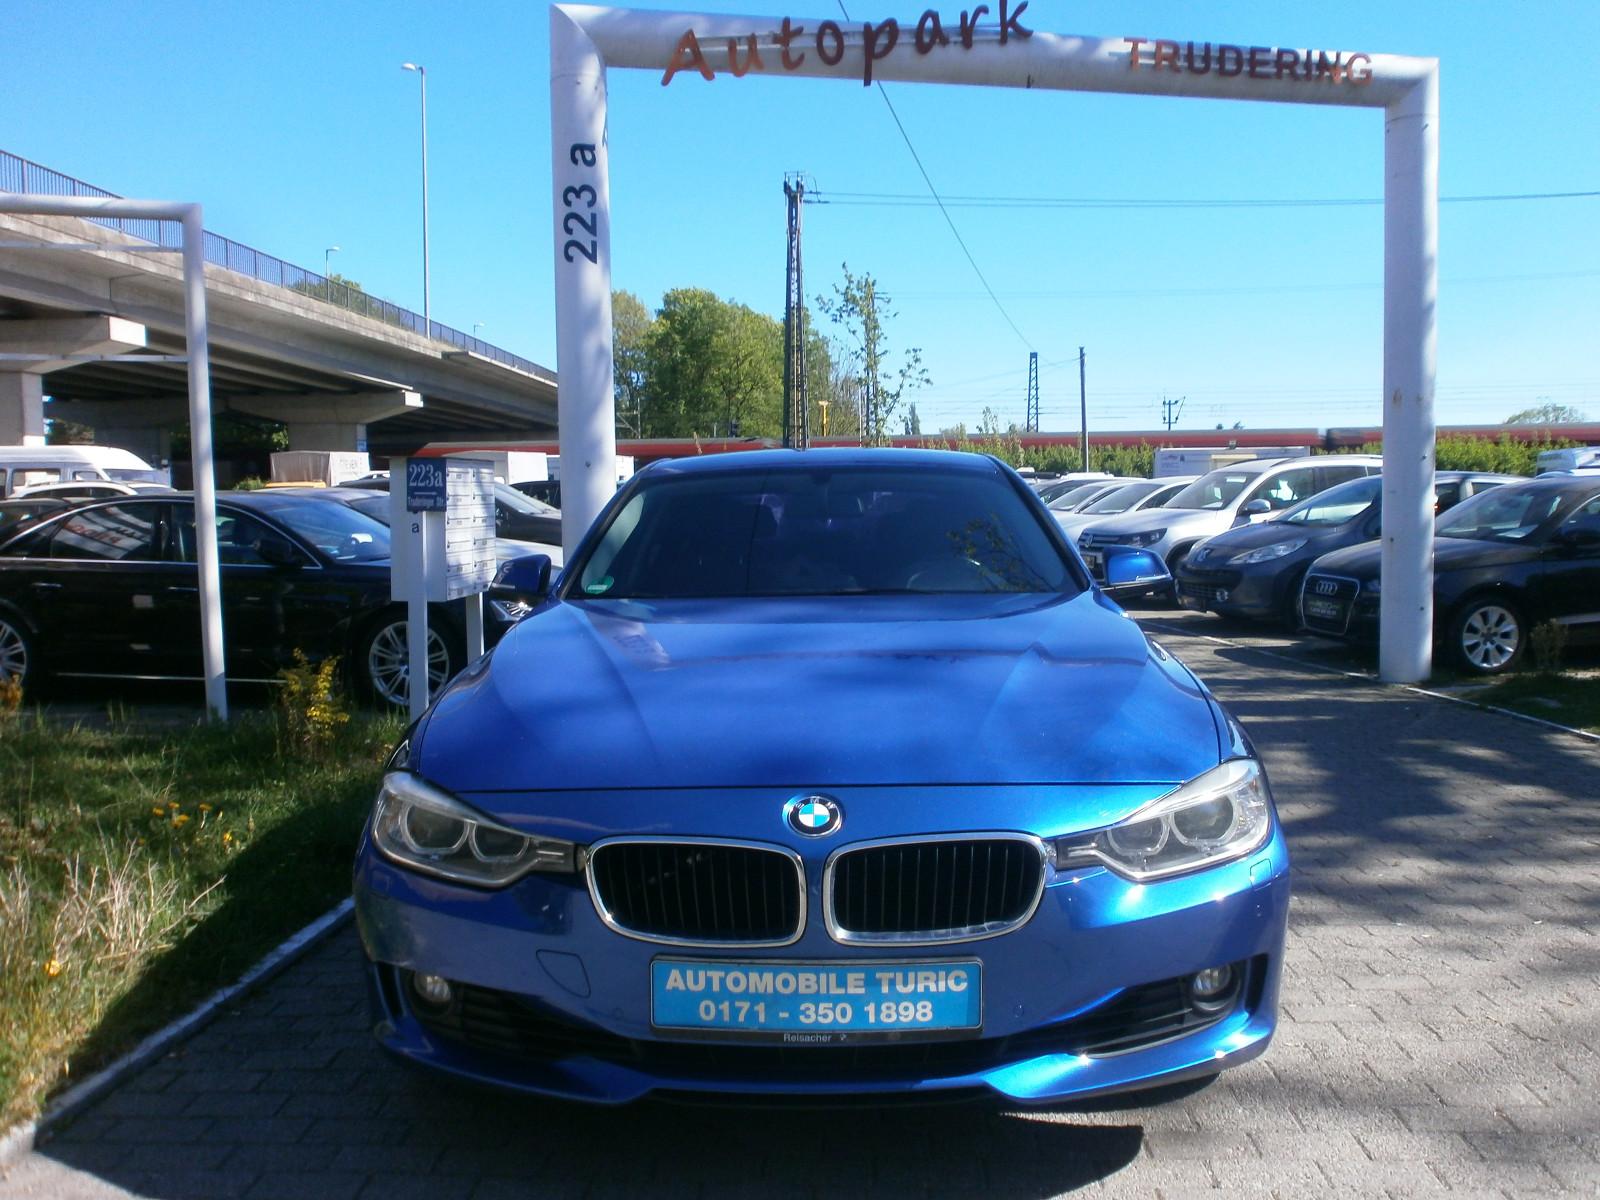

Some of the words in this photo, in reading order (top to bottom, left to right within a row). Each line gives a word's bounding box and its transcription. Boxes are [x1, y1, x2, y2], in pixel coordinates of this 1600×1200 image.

[661, 0, 1034, 87] Autopark
[1123, 36, 1374, 86] TRUDERING
[570, 143, 597, 168] a
[562, 184, 598, 264] 223
[408, 464, 443, 487] 223a
[411, 522, 420, 534] a
[665, 969, 866, 995] AUTOMOBILE
[875, 970, 968, 993] TURIC
[699, 1000, 766, 1023] 0171
[799, 1003, 852, 1024] 350
[864, 1001, 933, 1024] 1898
